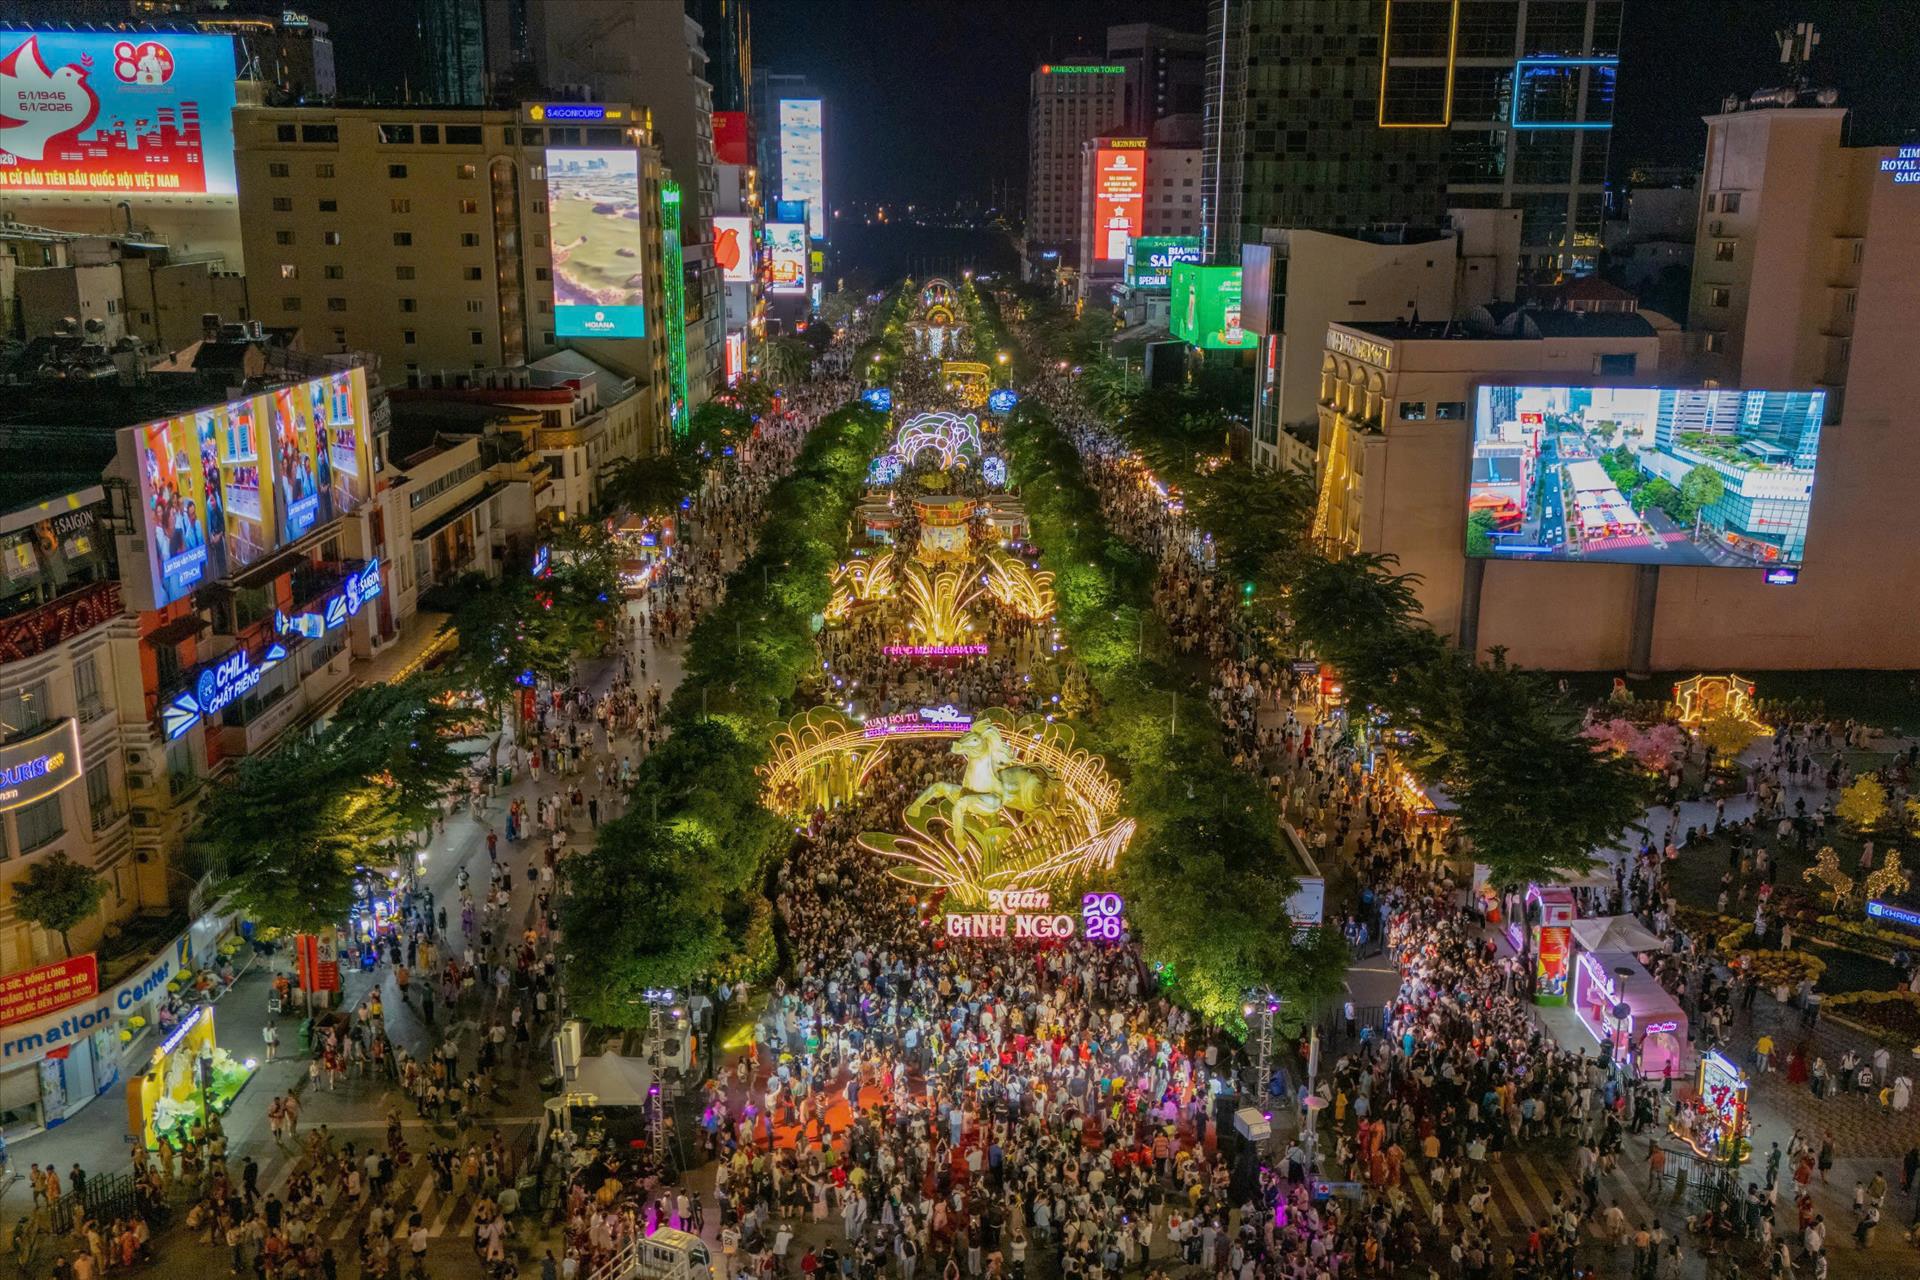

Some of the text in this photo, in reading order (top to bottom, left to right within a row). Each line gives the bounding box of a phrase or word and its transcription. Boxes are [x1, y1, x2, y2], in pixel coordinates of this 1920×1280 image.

[1083, 65, 1099, 73] VIEW
[1100, 65, 1125, 73] TOWER
[18, 91, 66, 101] 6/1/1946
[19, 103, 73, 112] 6/1/2026
[547, 108, 603, 118] SAIGONTOURIST
[1880, 160, 1917, 171] ROYAL
[157, 174, 179, 187] NAM
[1168, 246, 1184, 255] BIA
[58, 511, 95, 533] SAIGON
[216, 650, 249, 688] CHILL
[234, 668, 260, 698] RIÊNG
[1082, 894, 1121, 917] 20
[1882, 908, 1917, 923] KHANG
[1085, 916, 1120, 938] 26
[117, 960, 171, 1010] Center
